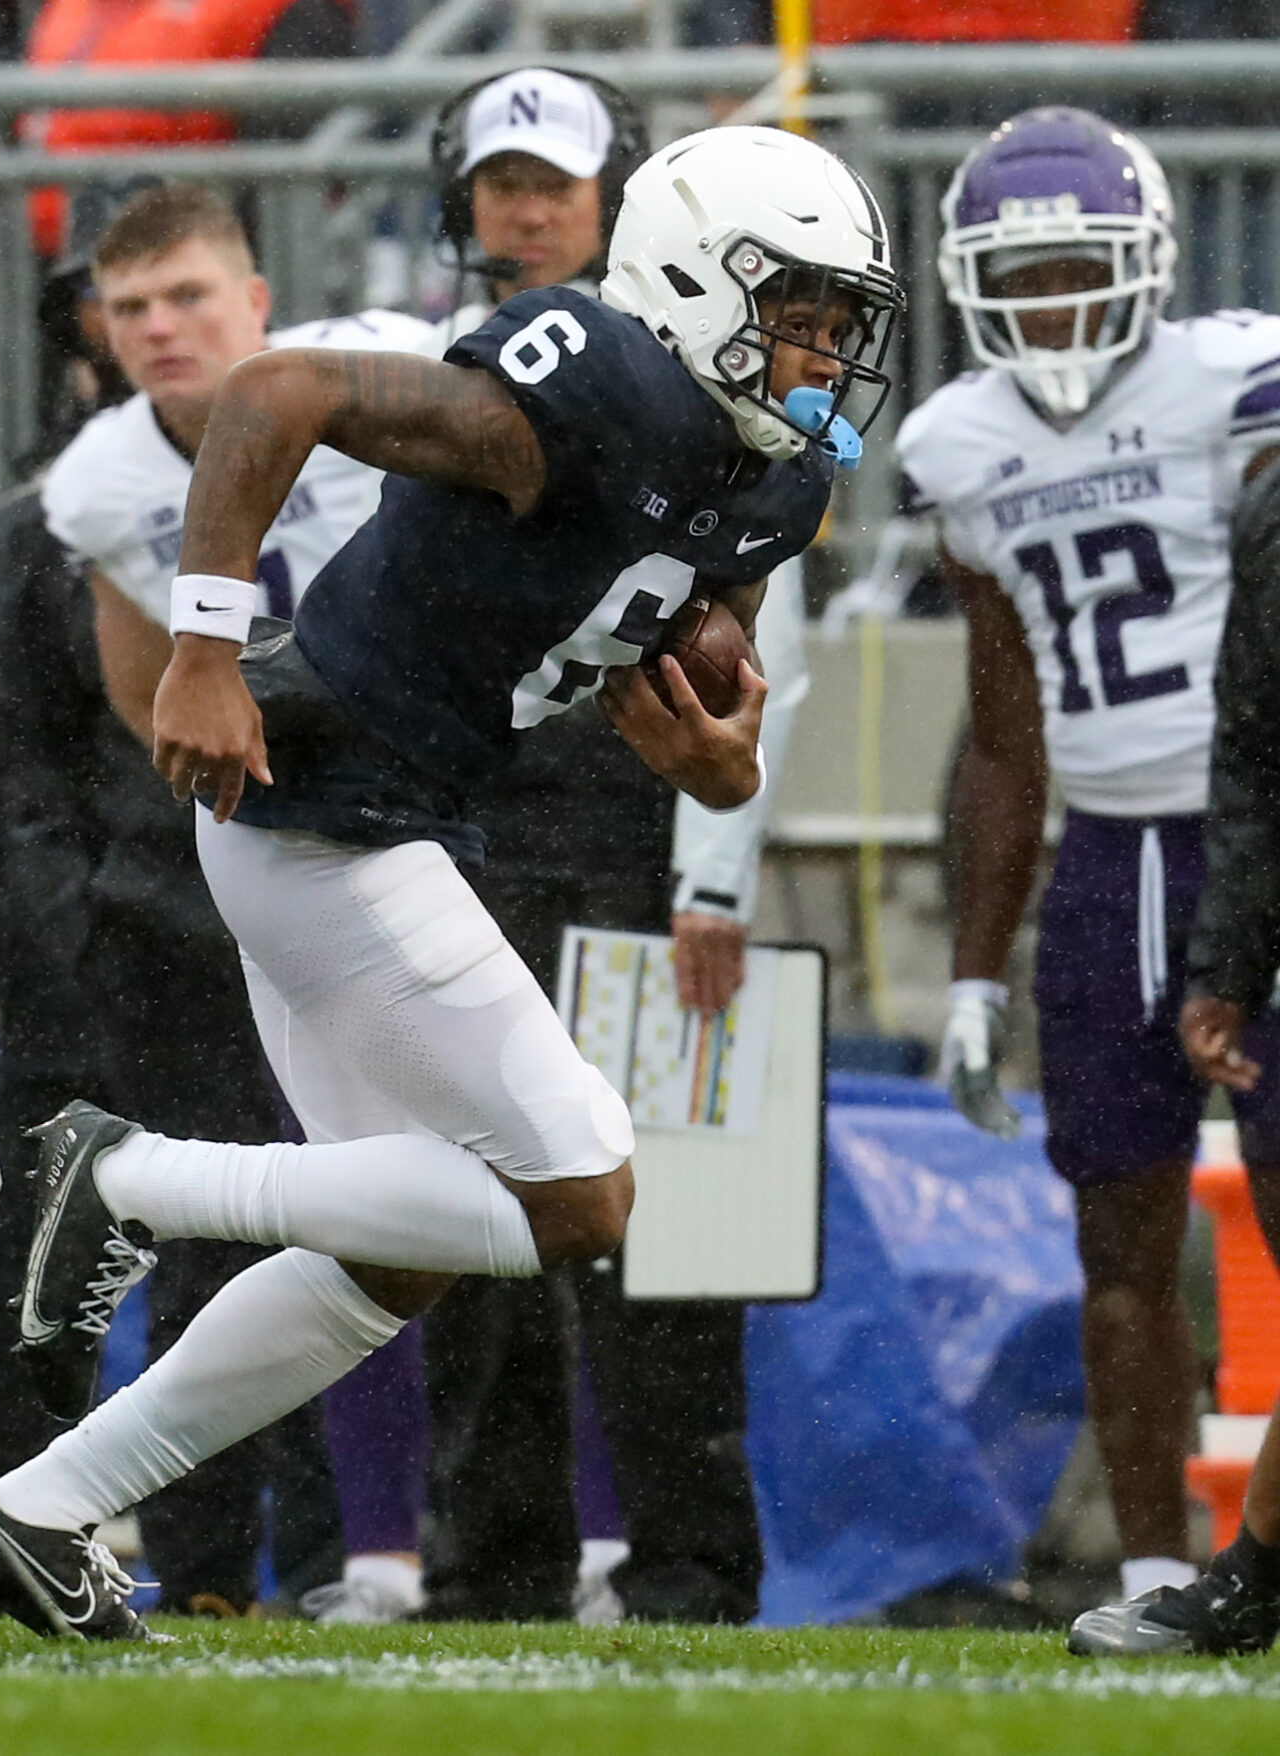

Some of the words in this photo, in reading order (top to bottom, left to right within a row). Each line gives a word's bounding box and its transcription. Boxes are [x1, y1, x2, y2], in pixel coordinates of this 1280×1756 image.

[508, 89, 540, 126] N
[498, 309, 587, 385] 6
[510, 552, 696, 730] 6
[1014, 521, 1190, 713] 12
[46, 1134, 72, 1188] VAPOR
